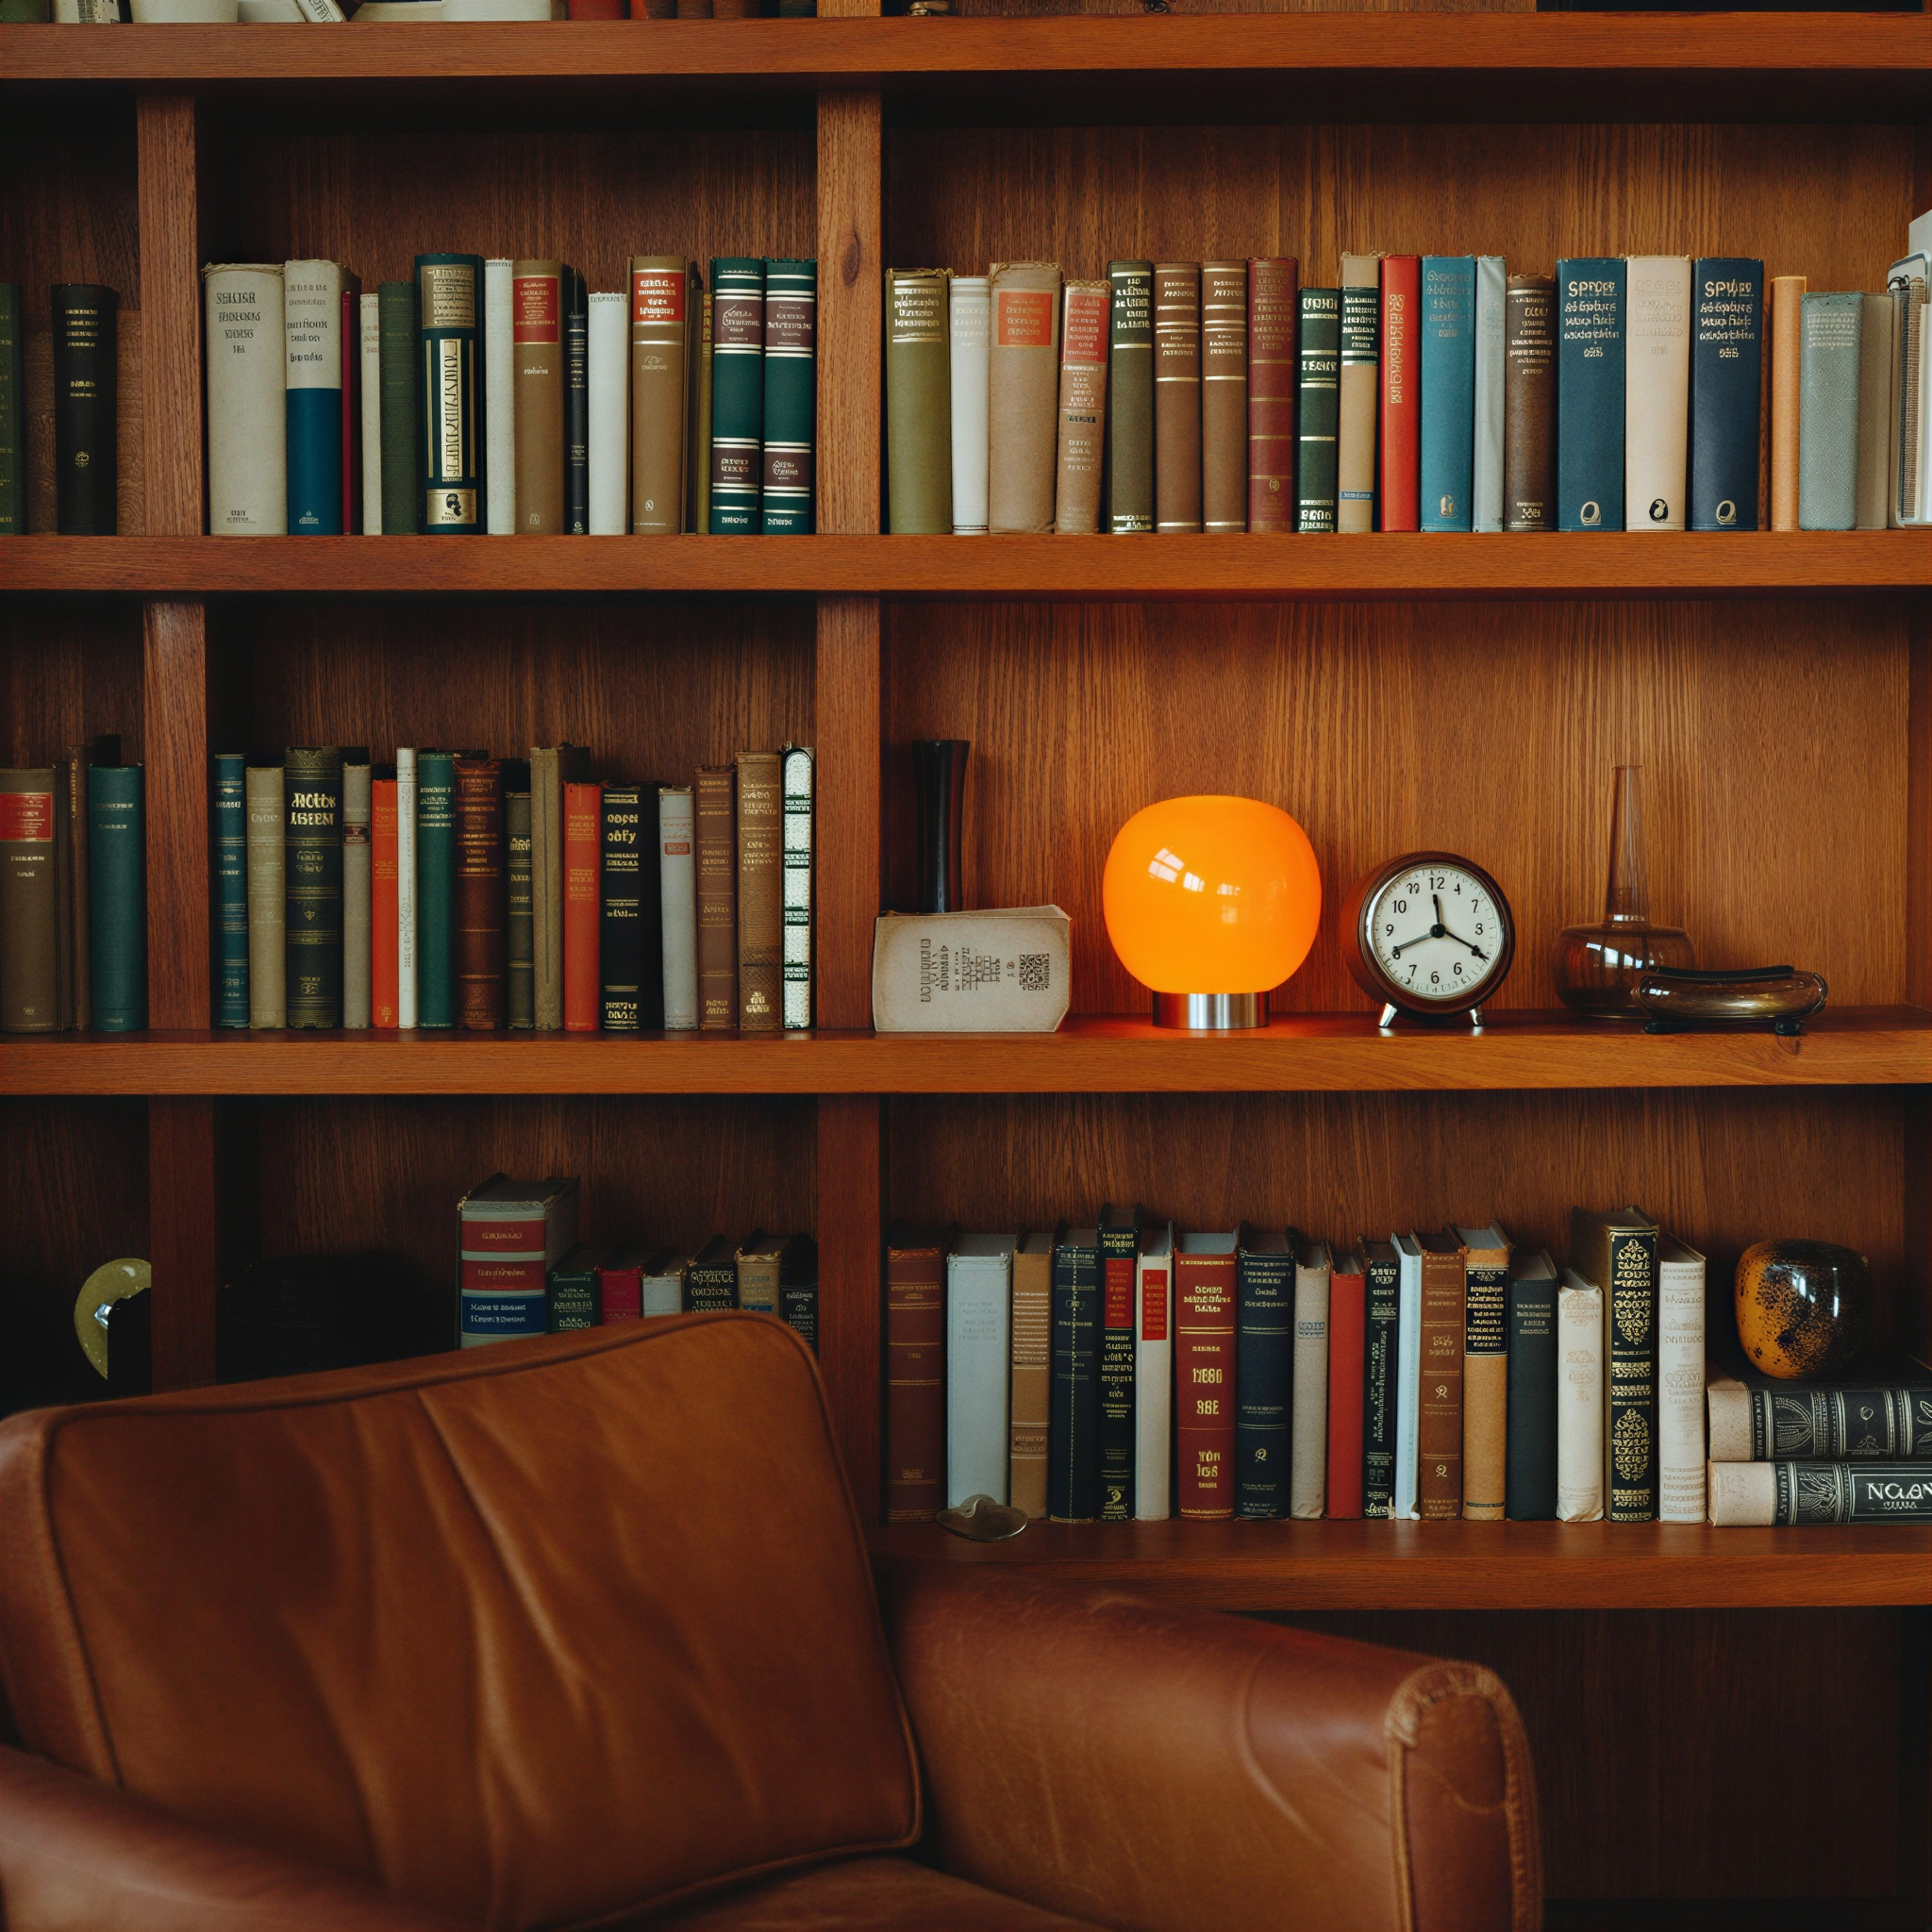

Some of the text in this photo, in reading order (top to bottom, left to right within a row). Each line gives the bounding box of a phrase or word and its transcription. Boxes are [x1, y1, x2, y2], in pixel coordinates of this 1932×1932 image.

[1428, 876, 1445, 891] 12
[1391, 900, 1407, 913] 10
[1386, 924, 1394, 937] 9
[1474, 923, 1484, 936] 3
[1408, 964, 1418, 977] 7
[1453, 962, 1462, 975] 6
[1430, 971, 1440, 984] 6
